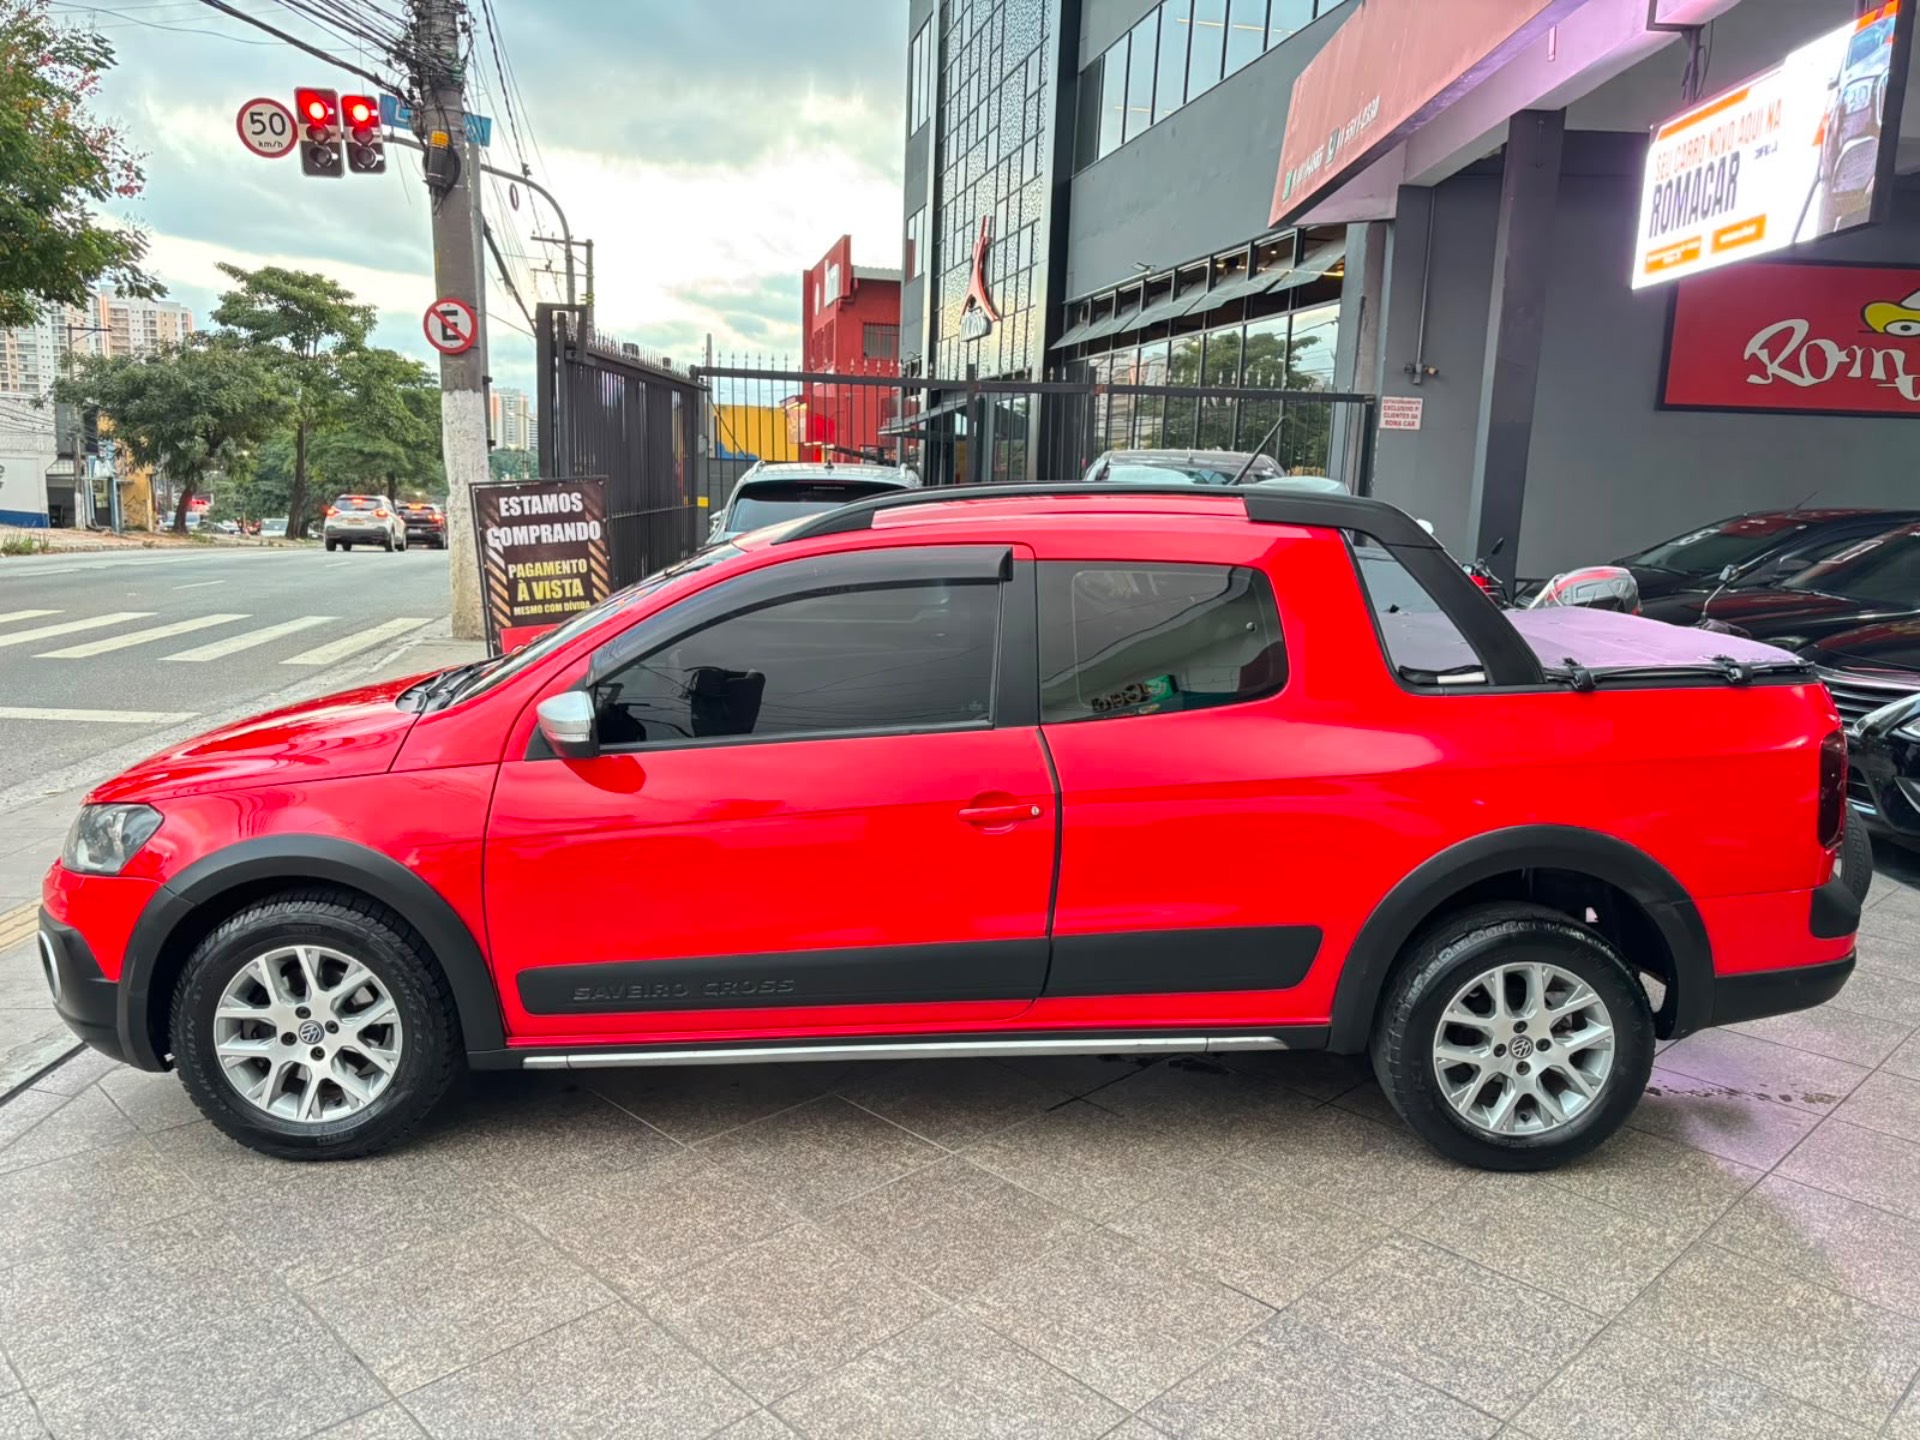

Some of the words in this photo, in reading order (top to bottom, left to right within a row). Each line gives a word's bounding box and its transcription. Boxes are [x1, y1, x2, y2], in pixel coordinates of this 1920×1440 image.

[249, 111, 286, 136] 50
[258, 140, 283, 148] km/h
[1707, 120, 1735, 157] NOVO
[1649, 150, 1740, 238] ROMACAR
[499, 492, 583, 517] ESTAMOS
[486, 520, 601, 550] COMPRANDO
[507, 558, 588, 579] PAGAMENTO
[517, 579, 530, 602] À
[532, 578, 584, 599] VISTA
[513, 604, 543, 616] MESMO
[544, 602, 563, 613] COM
[564, 600, 591, 612] DÍVIDA
[573, 983, 689, 1001] SAVEIRO
[703, 979, 796, 997] CROSS
